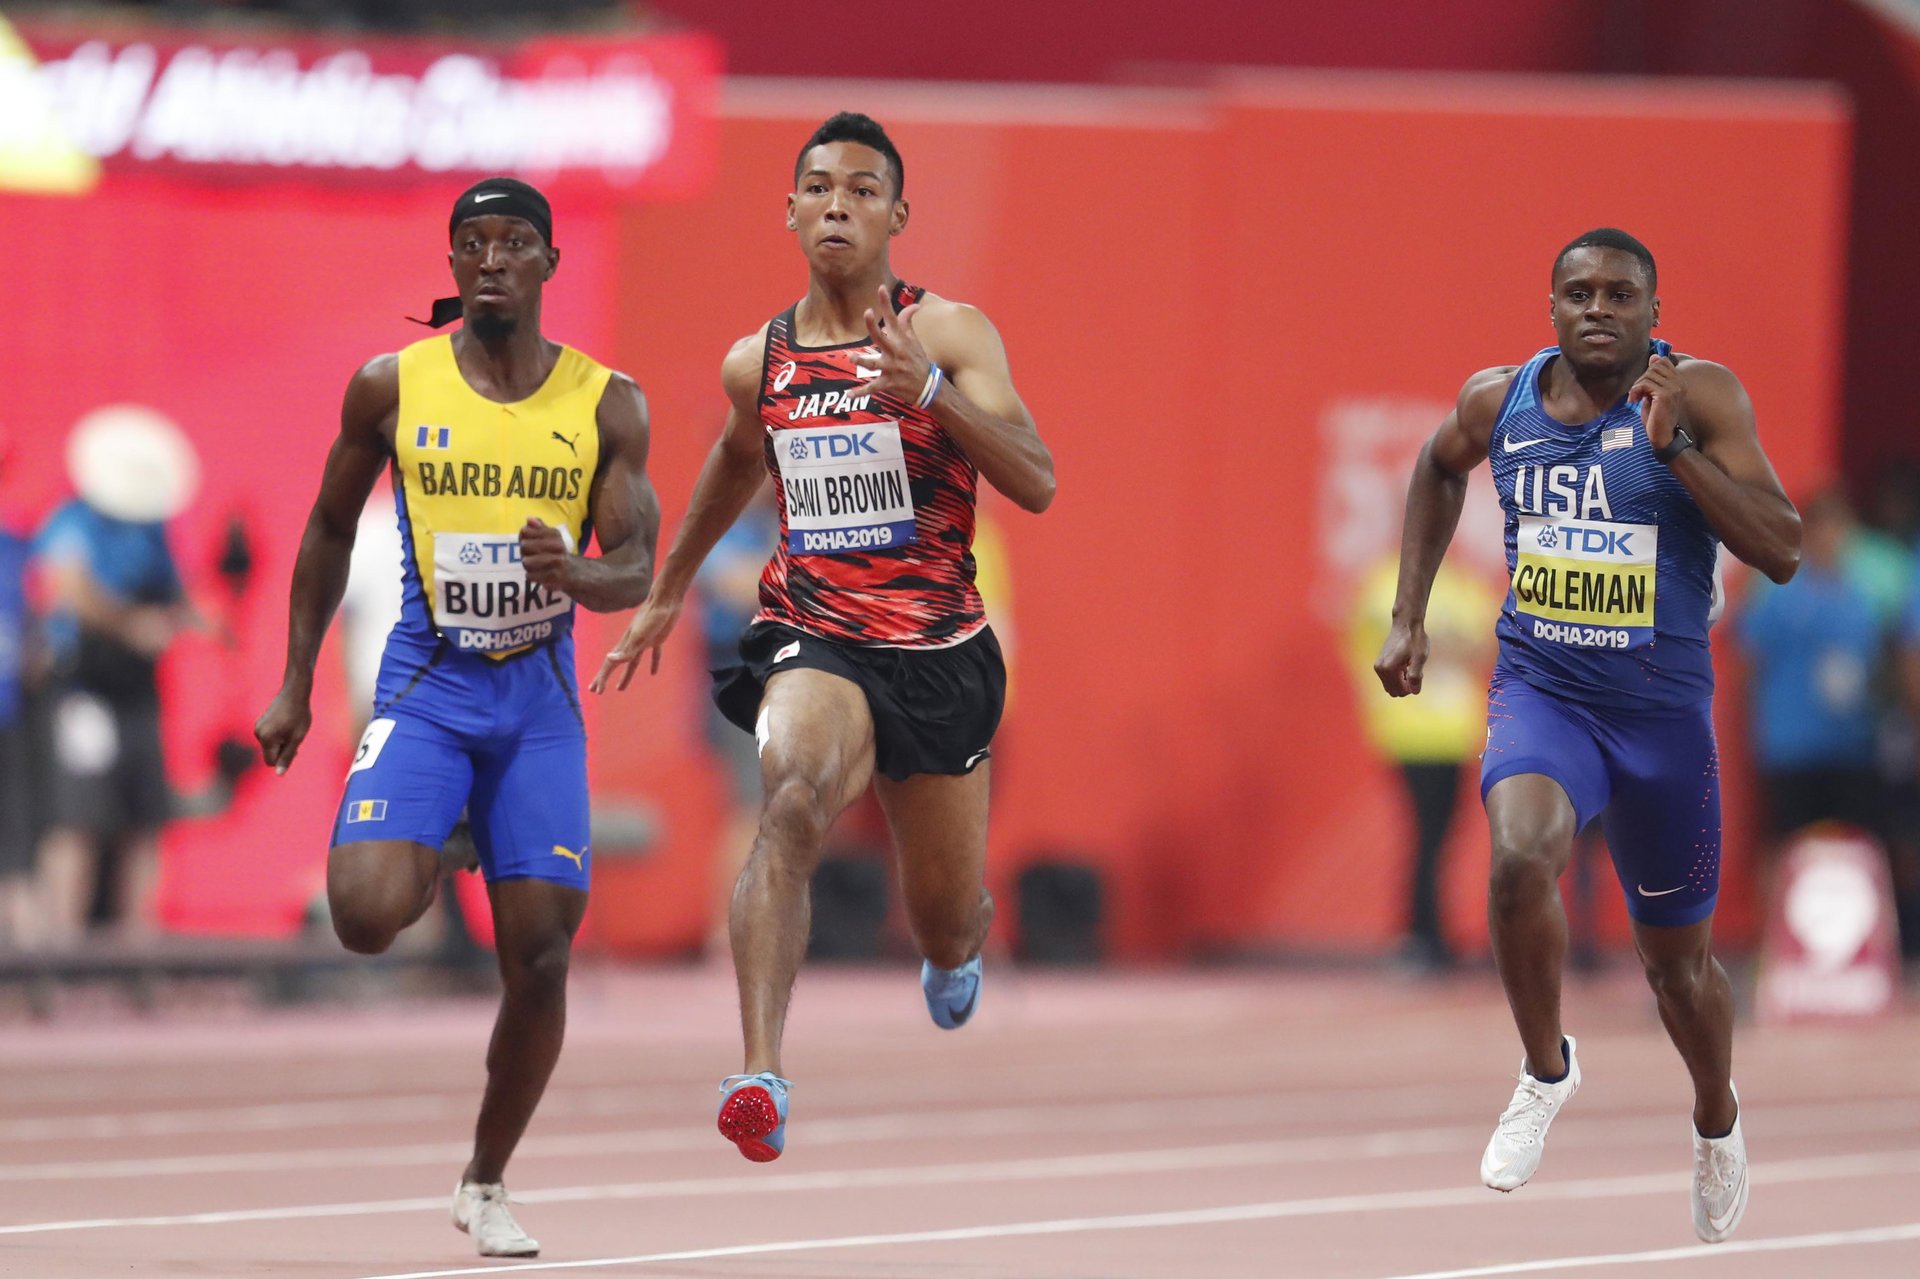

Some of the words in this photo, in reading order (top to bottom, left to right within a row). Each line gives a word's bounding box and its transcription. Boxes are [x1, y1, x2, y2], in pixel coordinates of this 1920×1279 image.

[788, 389, 871, 420] JAPAN
[806, 431, 879, 459] TDK
[418, 462, 583, 500] BARBADOS
[785, 477, 822, 517] SANI
[825, 470, 905, 515] BROWN
[1514, 464, 1613, 519] USA
[803, 526, 893, 550] DOHA2019
[1558, 526, 1634, 556] TDK
[482, 543, 522, 564] TD
[1517, 564, 1646, 613] COLEMAN
[459, 622, 552, 650] DOHA2019
[1533, 620, 1630, 648] DOHA2019
